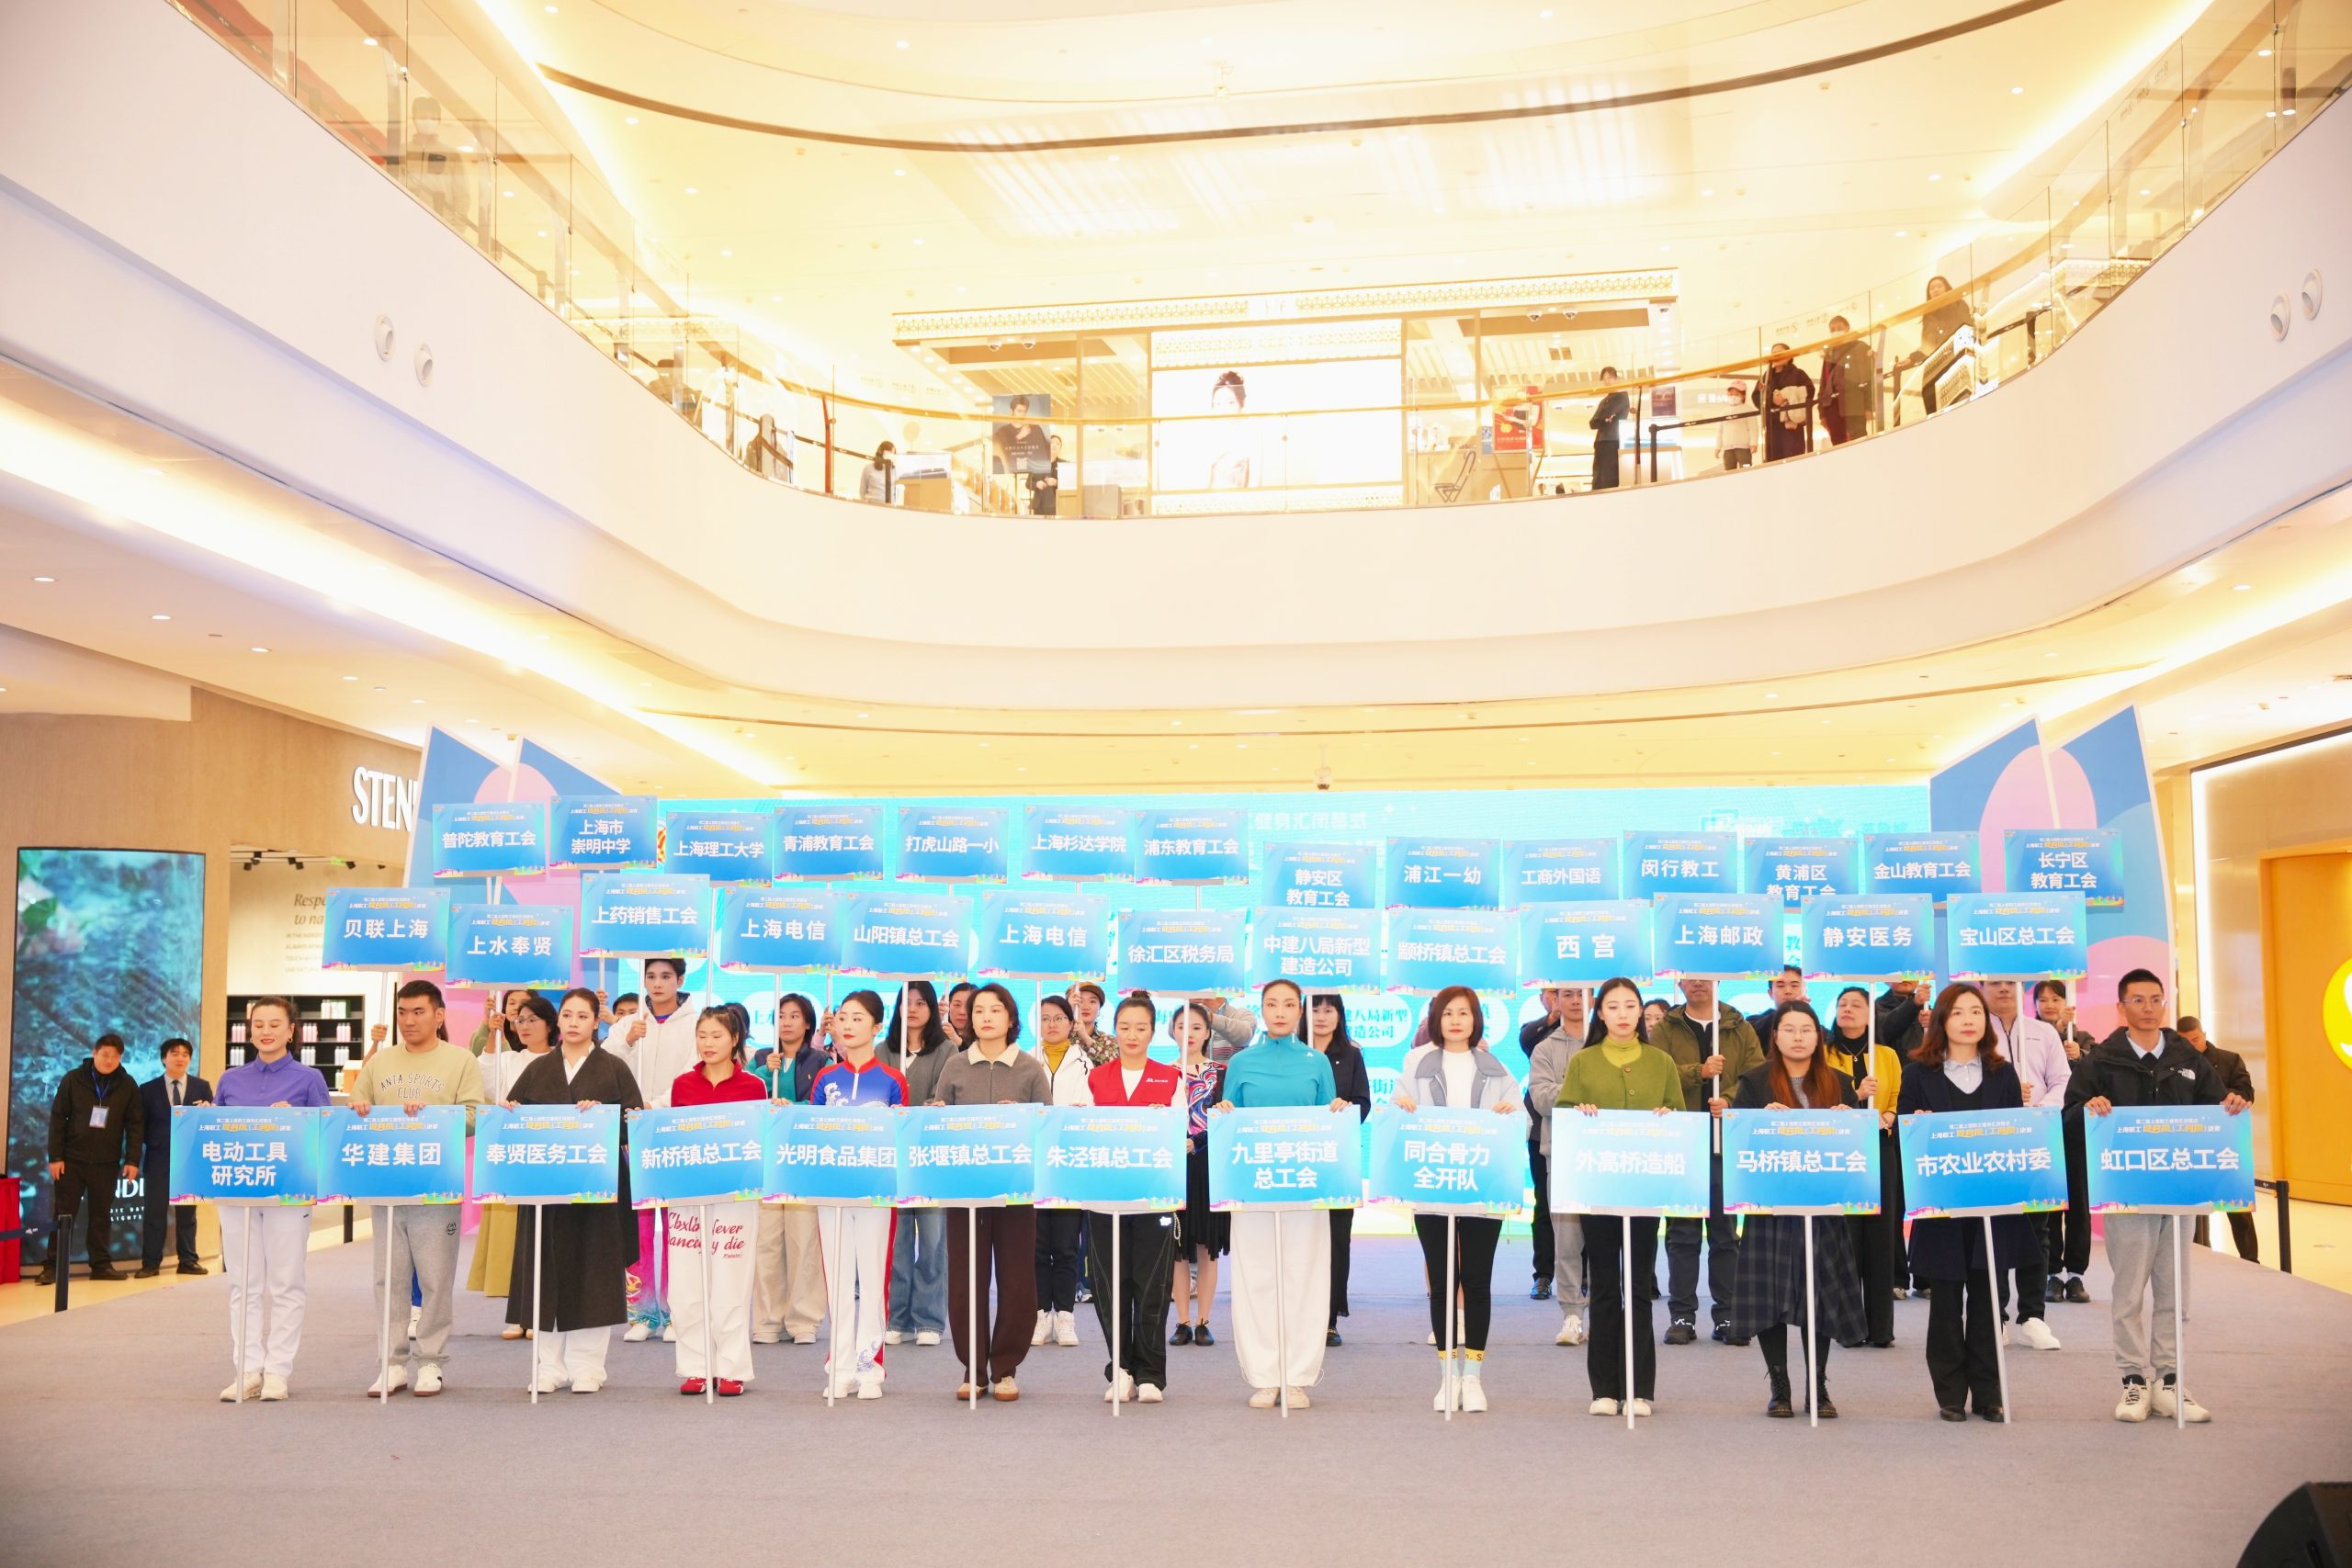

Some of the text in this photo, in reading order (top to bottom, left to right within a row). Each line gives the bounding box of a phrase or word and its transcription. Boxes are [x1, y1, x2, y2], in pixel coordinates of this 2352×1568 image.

[579, 819, 623, 836] 上海市
[443, 831, 536, 849] 普陀教育工会
[571, 838, 631, 854] 崇明中学
[673, 841, 764, 859] 上海理工大学
[784, 836, 874, 852] 青浦教育工会
[906, 836, 999, 853] 打虎山路一小
[1032, 834, 1126, 852] 上海杉达学院
[1145, 839, 1238, 856] 浦东教育工会
[1641, 859, 1719, 878] 闵行教工
[1874, 862, 1971, 880] 金山教育工会
[2038, 852, 2088, 869] 长宁区
[1295, 869, 1343, 886] 静安区
[1404, 865, 1481, 885] 浦江一幼
[1521, 867, 1601, 886] 工商外国语
[1775, 864, 1827, 881] 黄浦区
[2030, 872, 2097, 890] 教育工会
[1286, 888, 1350, 907] 教育工会
[591, 906, 698, 926] 上药销售工会
[344, 919, 429, 939] 贝联上海
[741, 919, 827, 941] 上海电信
[854, 924, 959, 948] 山阳镇总工会
[1000, 925, 1088, 948] 上海电信
[1675, 925, 1764, 947] 上海邮政
[1823, 926, 1913, 948] 静安医务
[1959, 926, 2075, 947] 宝山区总工会
[467, 935, 552, 956] 上水奉贤
[1127, 944, 1235, 964] 徐汇区税务局
[1263, 934, 1371, 956] 中建八局新型
[1555, 933, 1616, 960] 西宫
[1280, 956, 1352, 976] 建造公司
[380, 1073, 445, 1093] ANTA SPORTS
[397, 1087, 422, 1099] CLUB
[202, 1140, 288, 1163] 电动工具
[341, 1142, 441, 1166] 华建集团
[485, 1143, 607, 1166] 奉贤医务工会
[641, 1139, 763, 1169] 新桥镇总工会
[776, 1145, 897, 1168] 光明食品集团
[909, 1142, 1032, 1168] 张堰镇总工会
[1046, 1145, 1173, 1169] 朱泾镇总工会
[1231, 1139, 1338, 1165] 九里亭街道
[1404, 1140, 1490, 1165] 同合骨力
[1736, 1149, 1867, 1174] 马桥镇总工会
[1915, 1146, 2052, 1177] 市农业农村委
[2100, 1147, 2240, 1171] 虹口区总工会
[1575, 1149, 1686, 1176] 外高桥造船
[210, 1165, 277, 1187] 研究所
[1253, 1166, 1318, 1190] 总工会
[1413, 1167, 1479, 1191] 全开队
